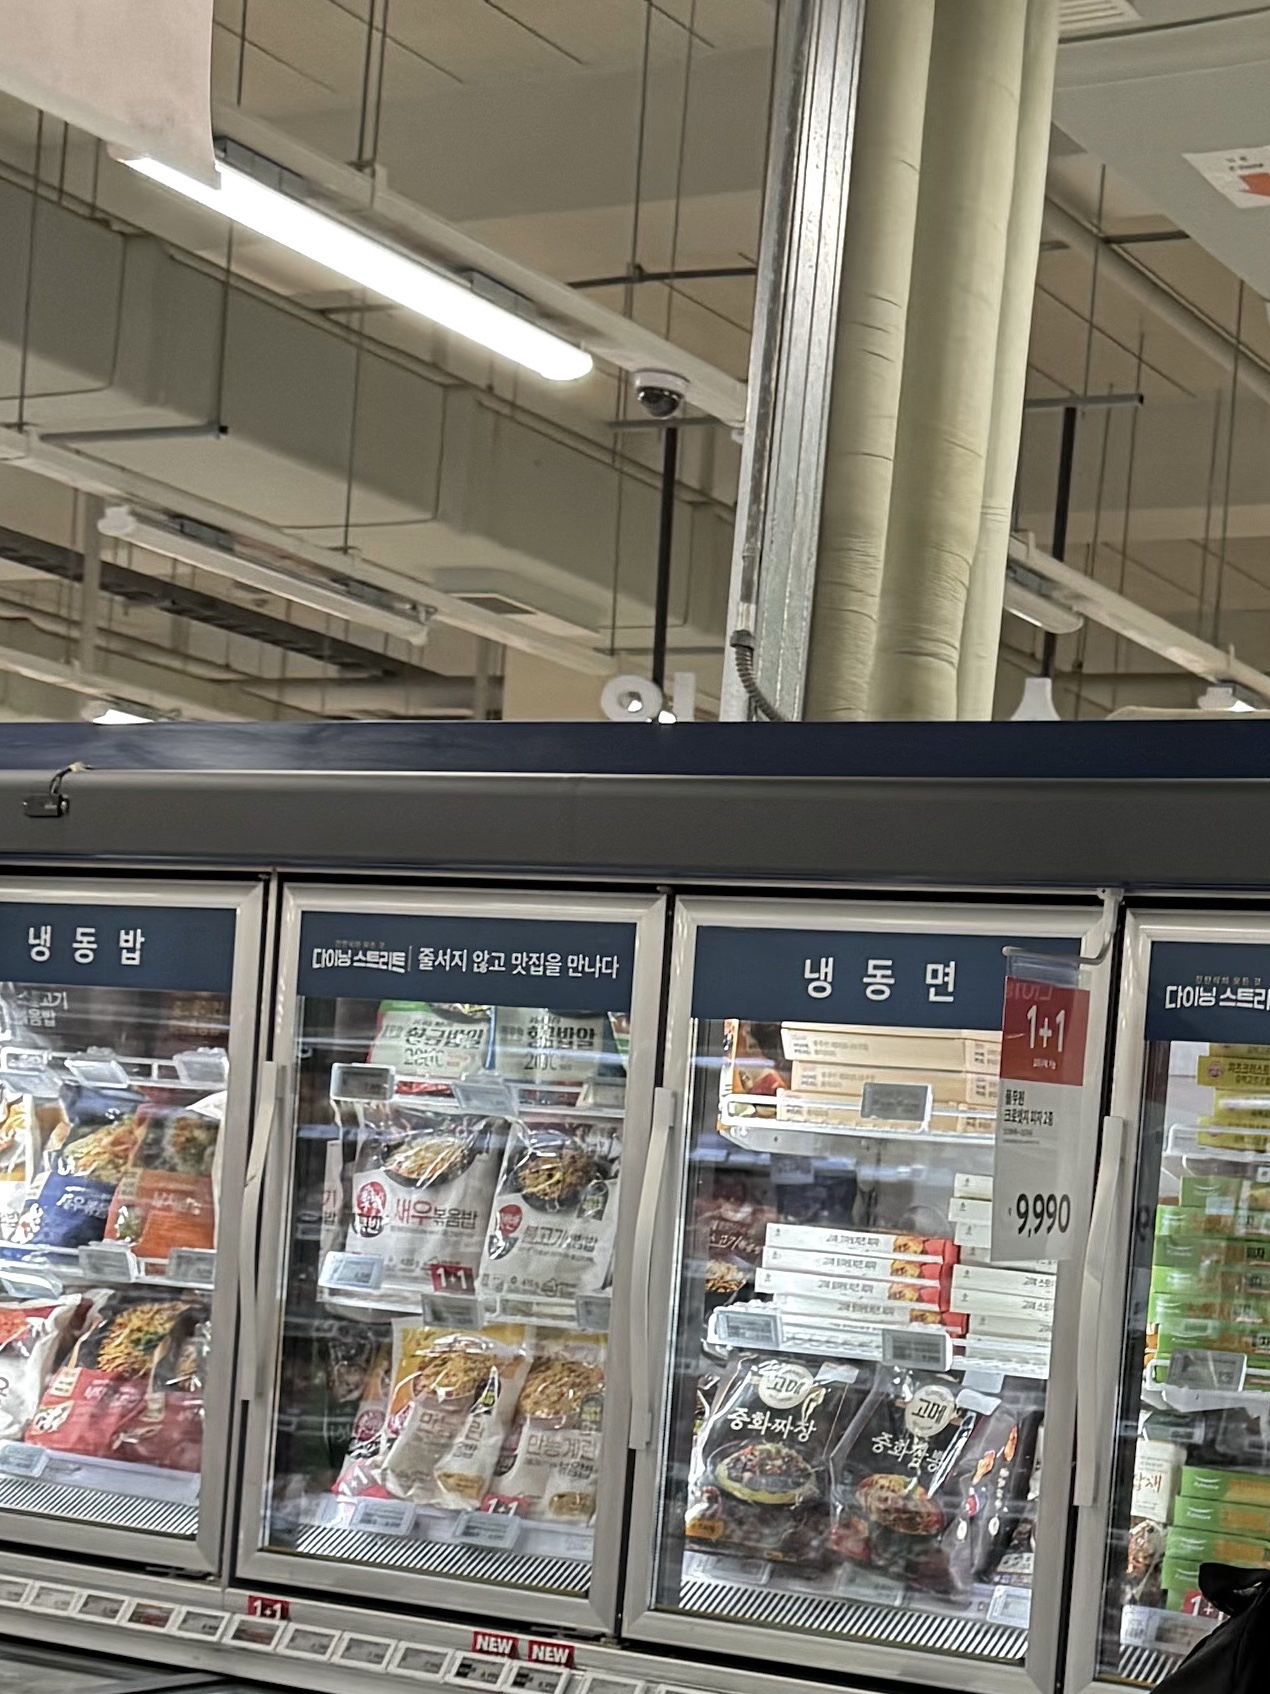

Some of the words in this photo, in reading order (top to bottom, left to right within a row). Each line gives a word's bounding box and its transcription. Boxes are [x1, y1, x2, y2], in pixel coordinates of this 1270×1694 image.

[417, 947, 468, 973] 줄서지
[473, 950, 507, 974] 않고
[511, 951, 563, 977] 맛집을
[567, 954, 620, 979] 만나다
[1164, 984, 1217, 1010] 다이닝
[1026, 1004, 1066, 1053] 1+1
[1015, 1193, 1072, 1237] 9,990
[727, 1407, 817, 1443] 중화짜장
[911, 1397, 948, 1425] 고메
[252, 1599, 283, 1620] 1+1
[475, 1634, 514, 1654] NEW
[530, 1643, 570, 1664] NEW
